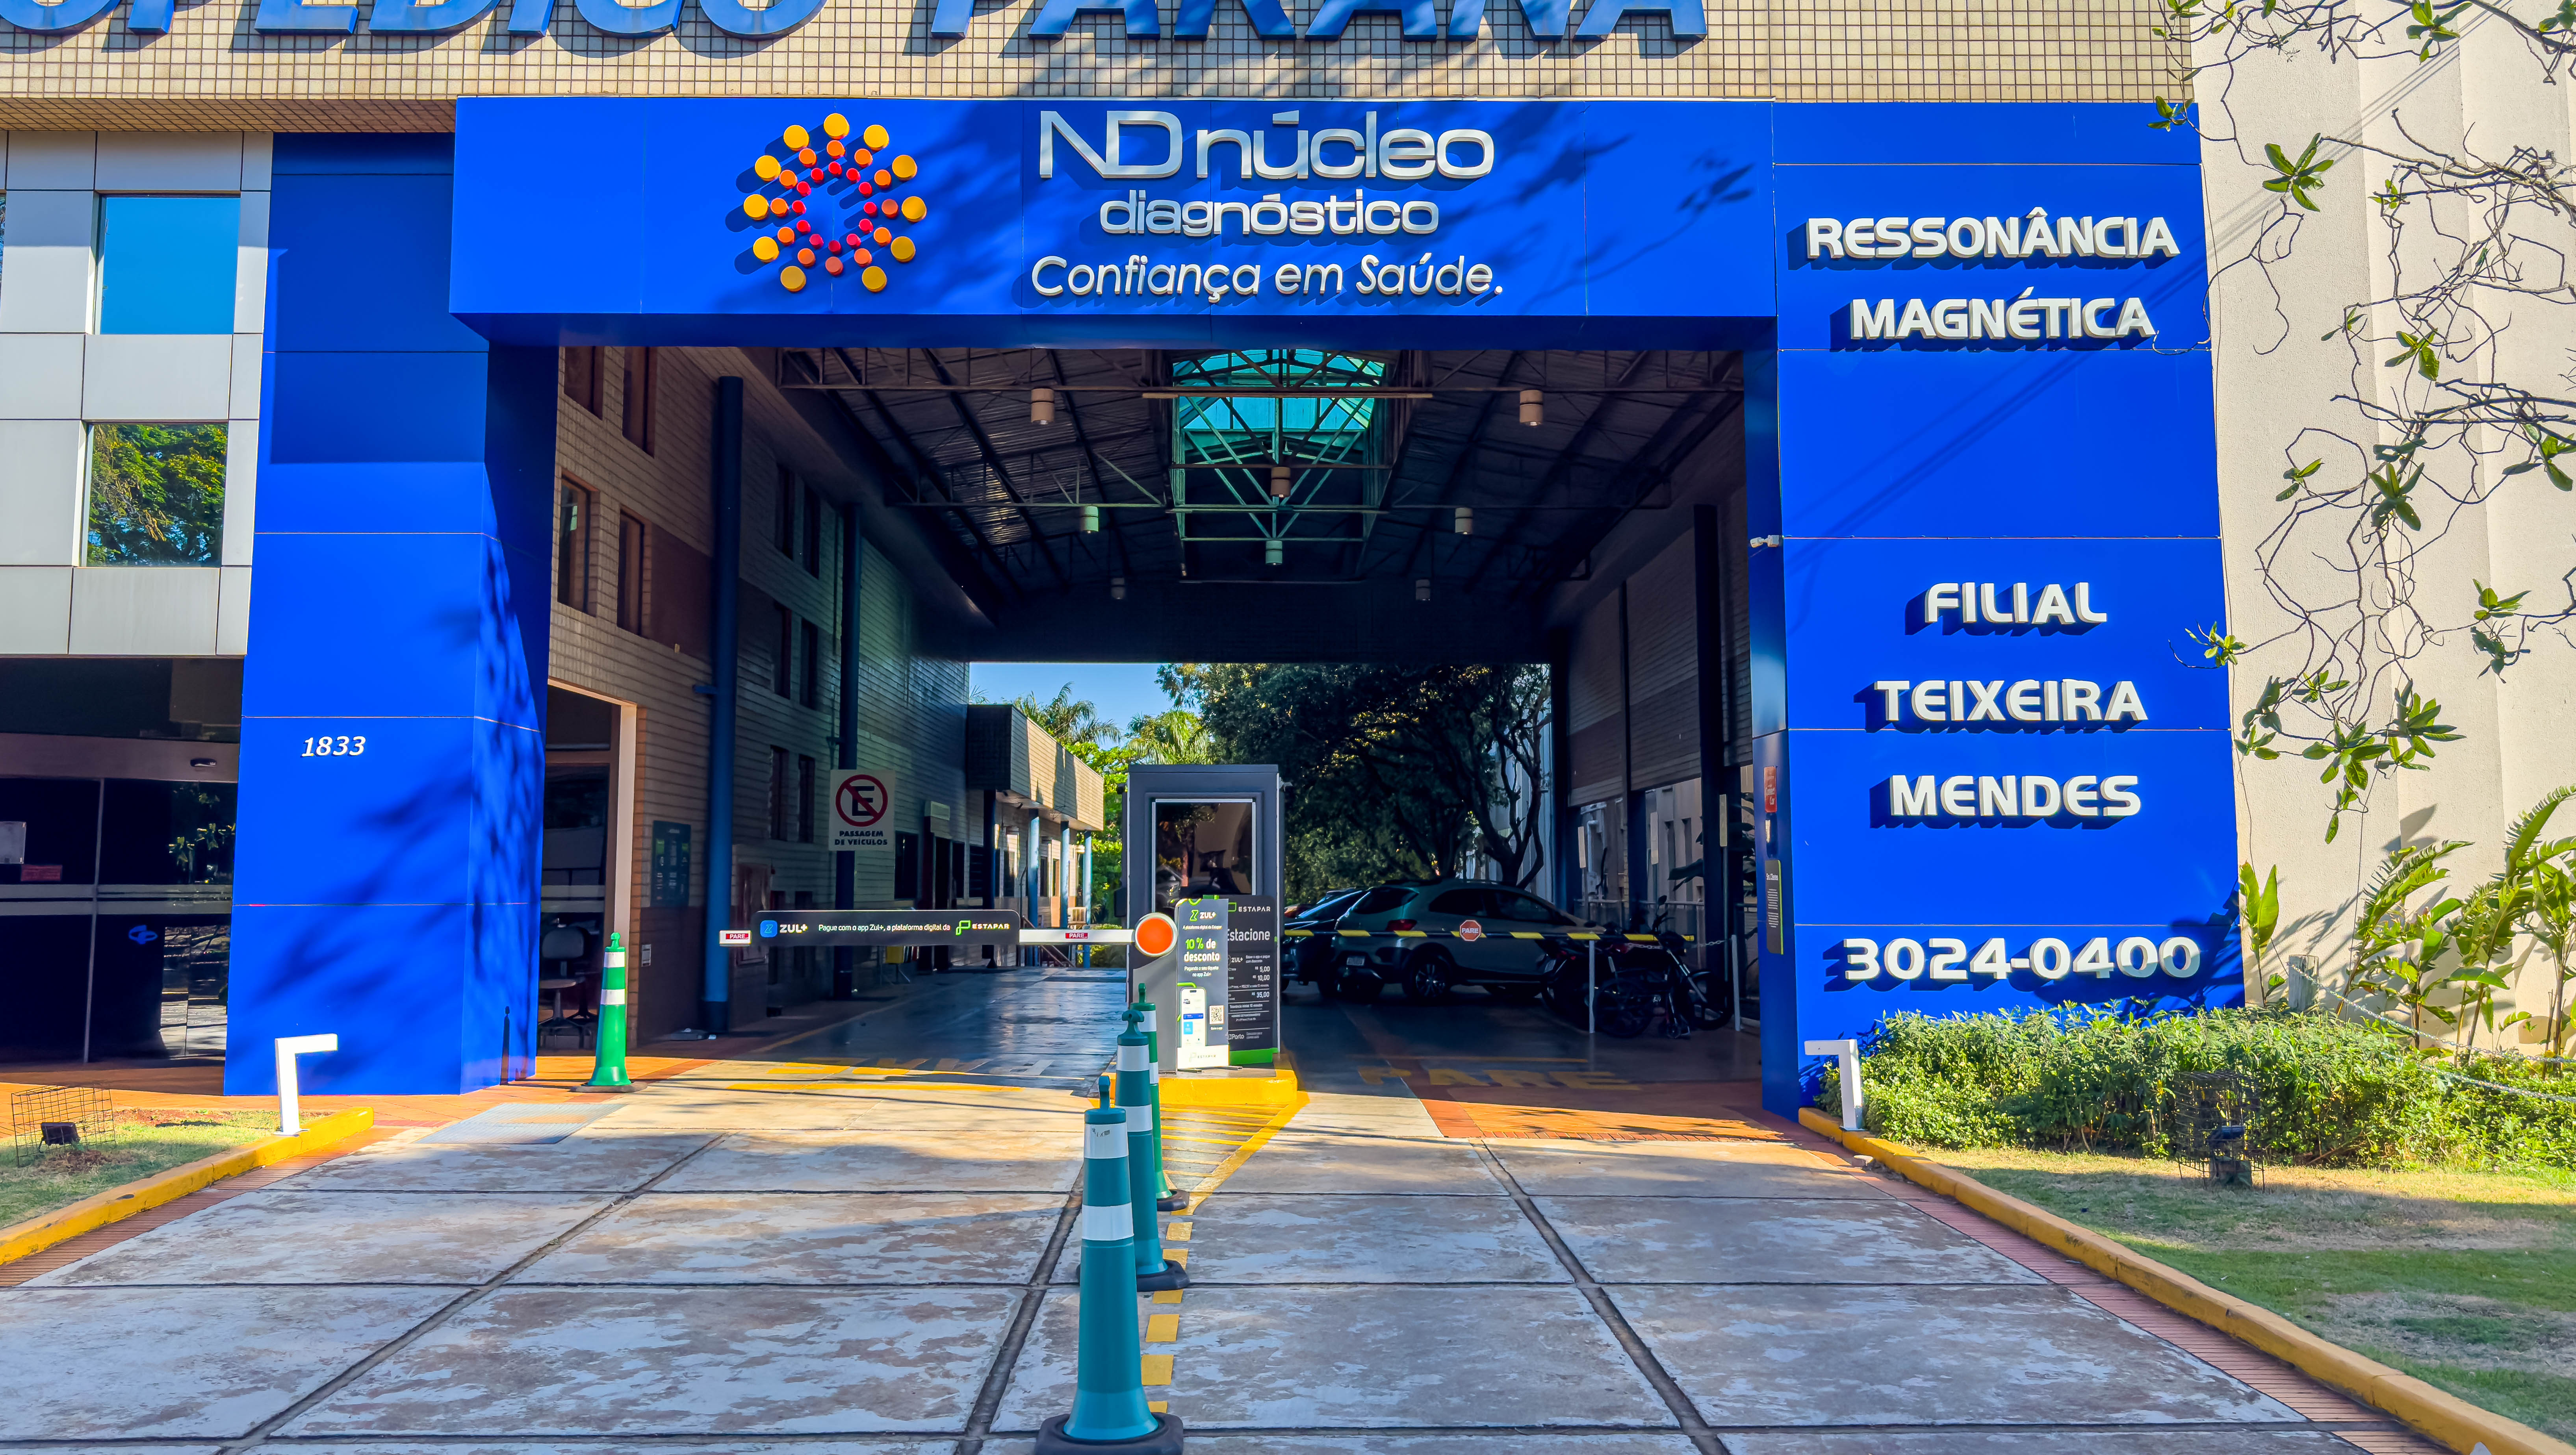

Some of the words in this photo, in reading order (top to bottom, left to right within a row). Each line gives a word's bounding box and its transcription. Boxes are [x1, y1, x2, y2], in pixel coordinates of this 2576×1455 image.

[1039, 110, 1183, 180] ND
[1197, 109, 1495, 180] núcleo
[1099, 189, 1440, 235] diagnóstico
[1807, 206, 2181, 259] RESSONÂNCIA
[1032, 254, 1260, 303] Confiança
[1275, 265, 1344, 295] em
[1356, 252, 1504, 297] Saúde.
[1850, 286, 2157, 340] MAGNÉTICA
[1924, 582, 2108, 624] FILIAL
[1873, 679, 2149, 722] TEIXEIRA
[301, 736, 366, 757] 1833
[1889, 775, 2142, 817] MENDES
[779, 923, 808, 934] ZUL+
[892, 924, 923, 932] plataforma
[924, 923, 942, 932] digital
[1206, 938, 1216, 949] de
[1184, 951, 1220, 962] desconto
[1843, 937, 2201, 981] 3024-0400
